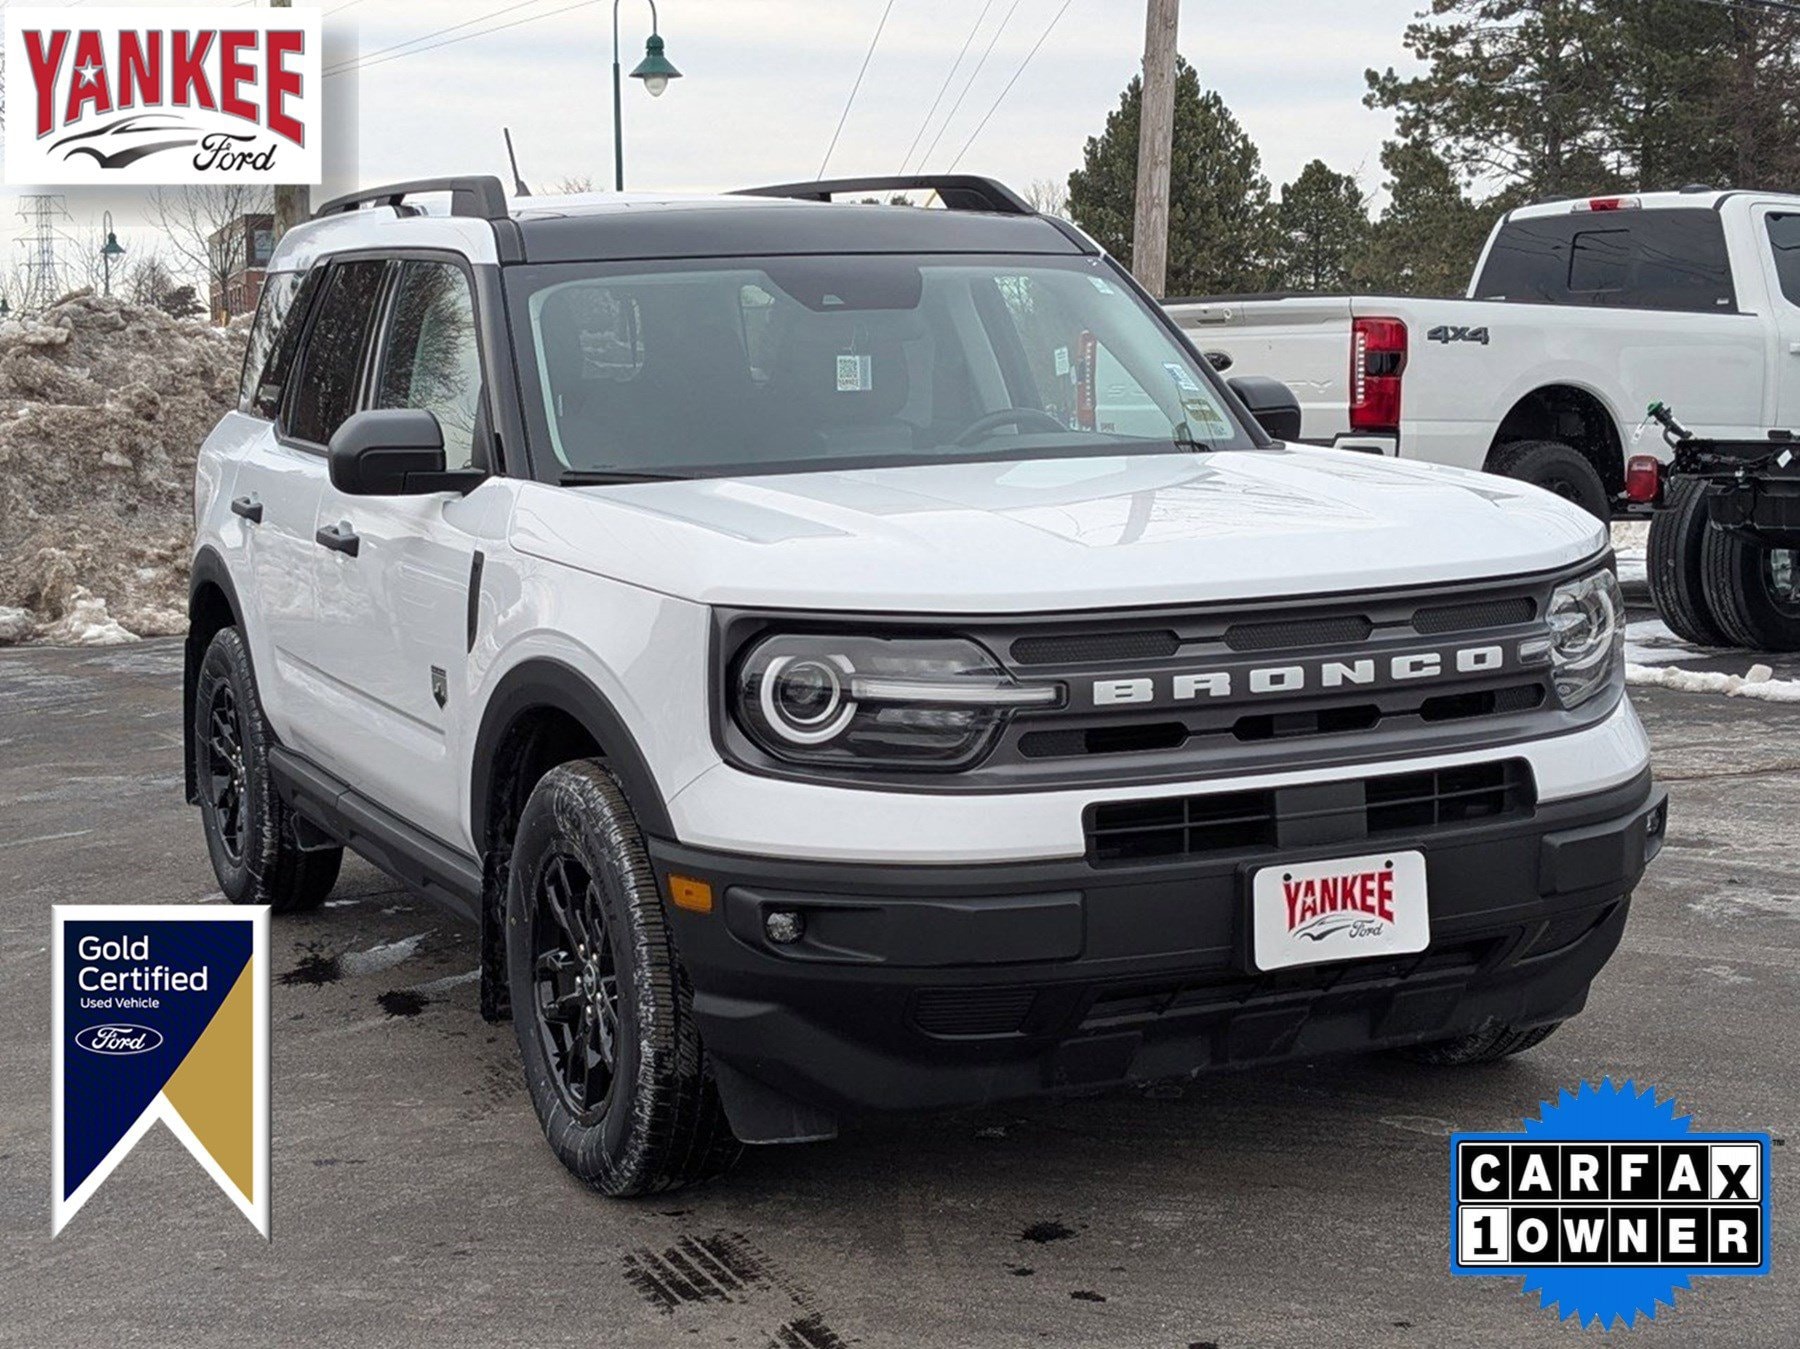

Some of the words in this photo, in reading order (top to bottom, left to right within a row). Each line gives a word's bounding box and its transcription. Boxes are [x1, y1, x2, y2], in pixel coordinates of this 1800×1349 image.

[1092, 645, 1504, 706] BRONCO
[1283, 870, 1395, 932] YANKEE
[1348, 919, 1384, 939] Ford
